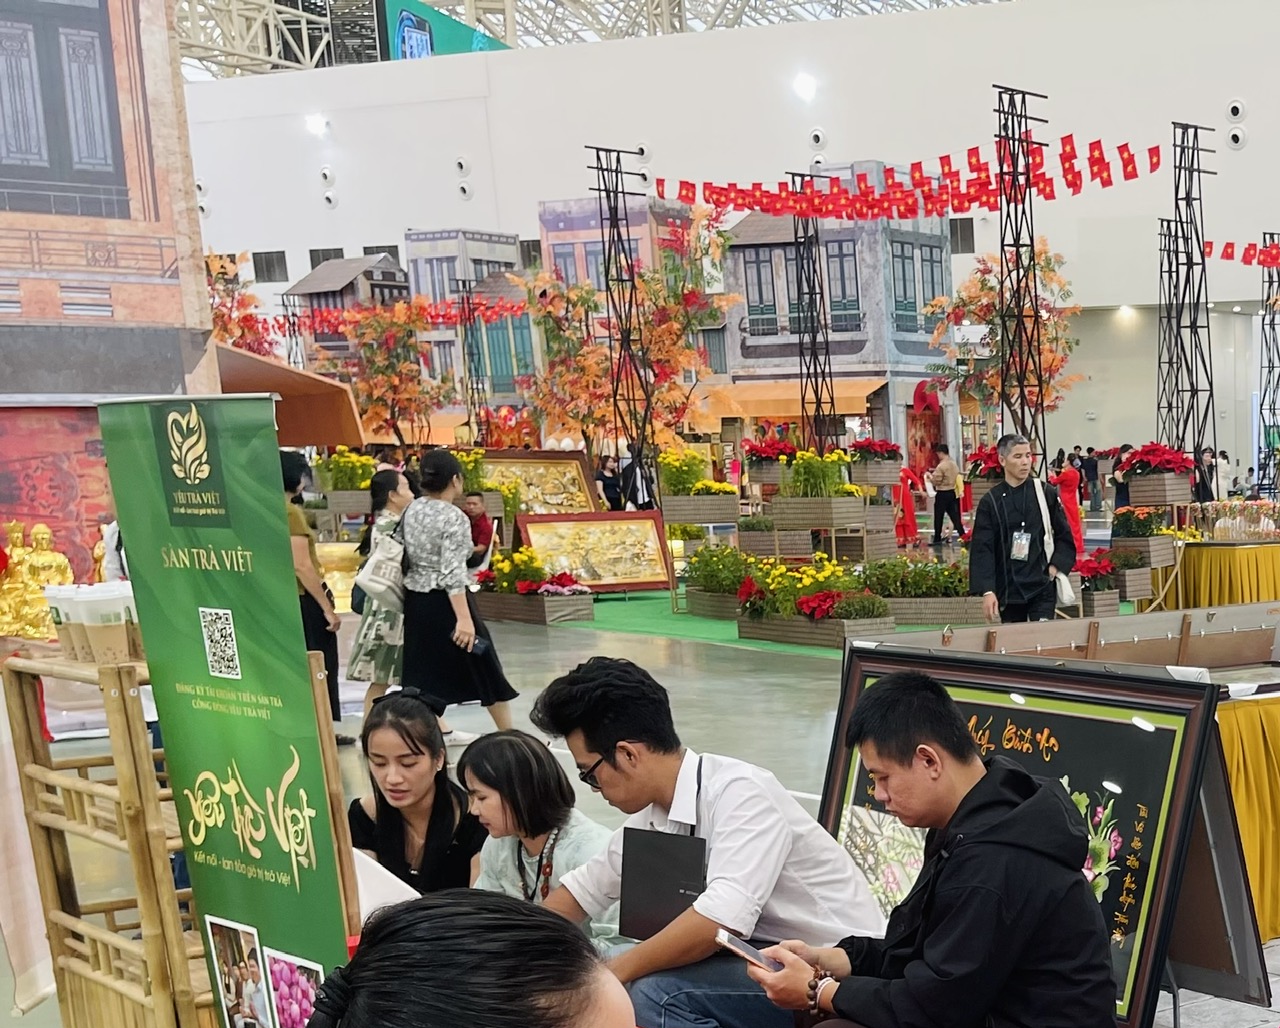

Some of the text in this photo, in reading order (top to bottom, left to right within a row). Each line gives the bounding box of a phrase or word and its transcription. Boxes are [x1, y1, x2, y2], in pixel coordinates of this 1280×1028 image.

[161, 543, 253, 577] SÀN TRÀ VIỆT
[220, 758, 267, 859] Trà
[266, 744, 317, 894] Việt
[276, 871, 291, 888] Việt
